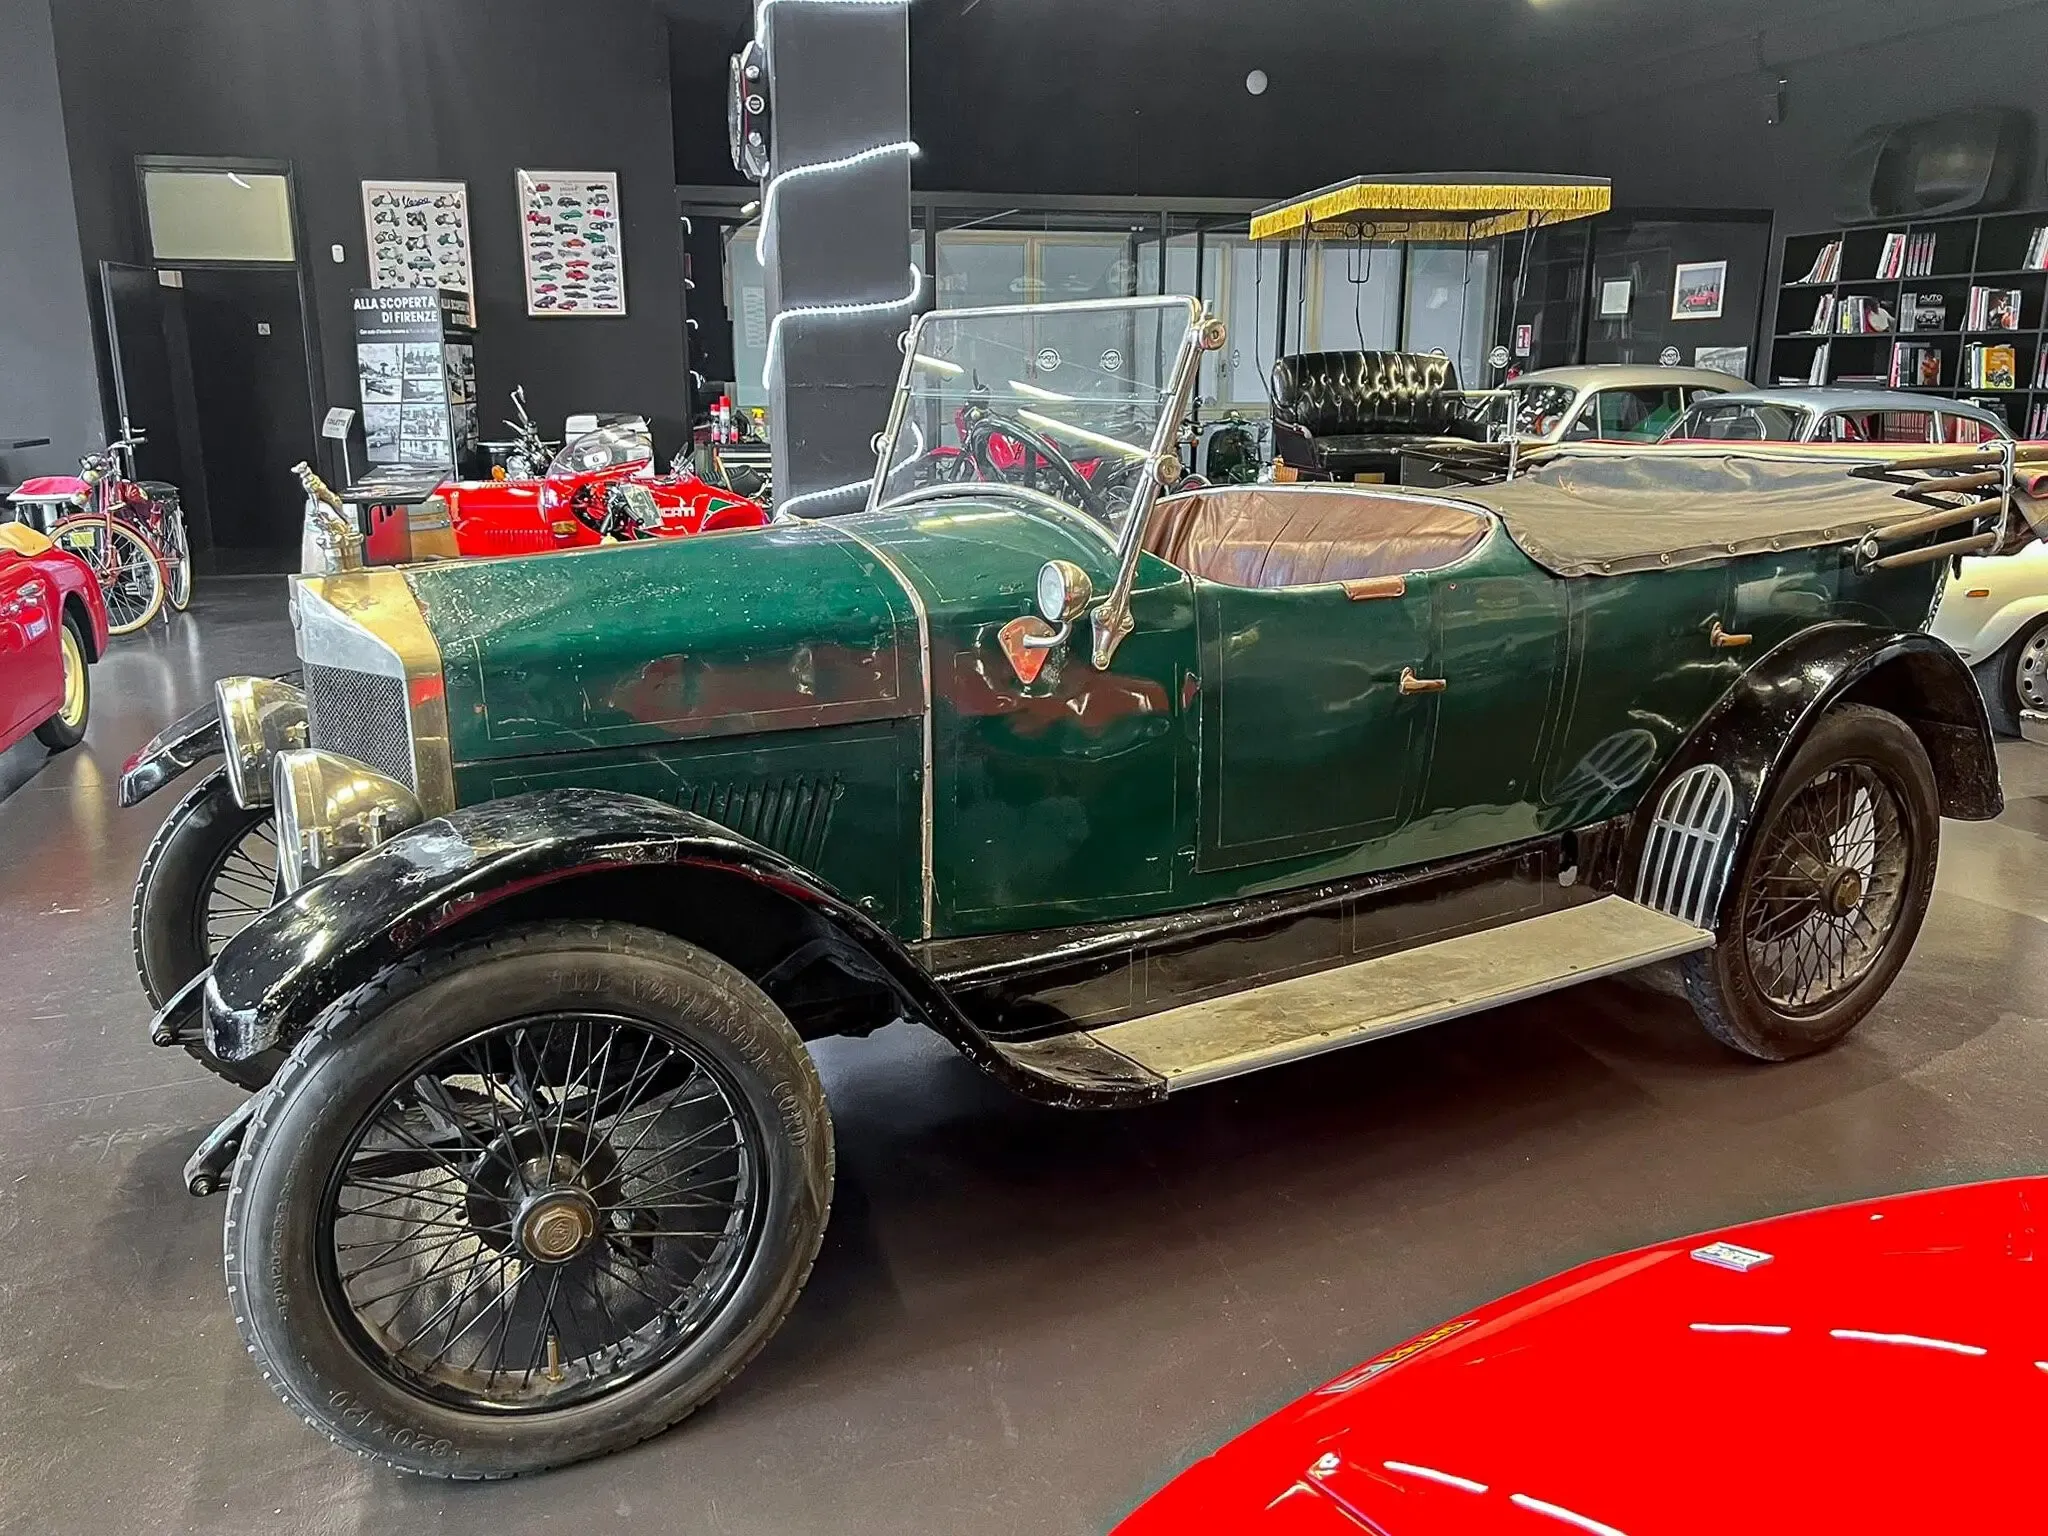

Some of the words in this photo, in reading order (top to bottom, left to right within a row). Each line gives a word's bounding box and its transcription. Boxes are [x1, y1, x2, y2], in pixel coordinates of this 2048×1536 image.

[354, 298, 379, 310] ALLA
[380, 296, 437, 309] SCOPERTA
[382, 312, 393, 323] DI
[394, 311, 438, 323] FIRENZE
